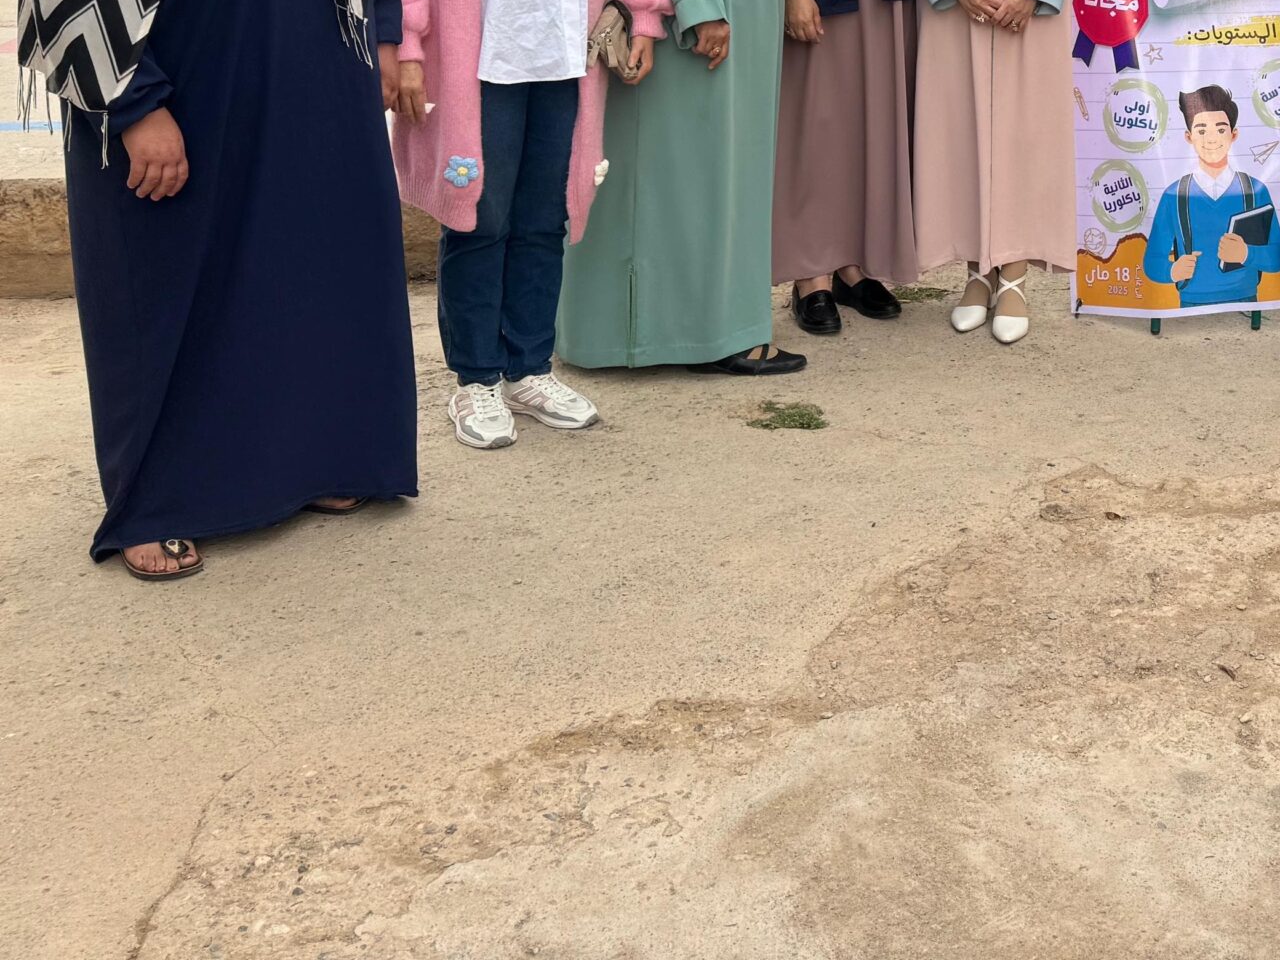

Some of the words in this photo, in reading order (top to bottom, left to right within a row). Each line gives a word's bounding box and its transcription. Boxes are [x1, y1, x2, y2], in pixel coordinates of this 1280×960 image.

[1187, 22, 1277, 46] المستويات:
[1124, 100, 1151, 116] أولى
[1113, 112, 1158, 134] باكلوريا
[1103, 176, 1133, 197] الثانية
[1103, 191, 1141, 214] باكلوريا
[1085, 264, 1110, 287] ماي
[1114, 266, 1130, 282] 18
[1107, 285, 1128, 295] 2025
